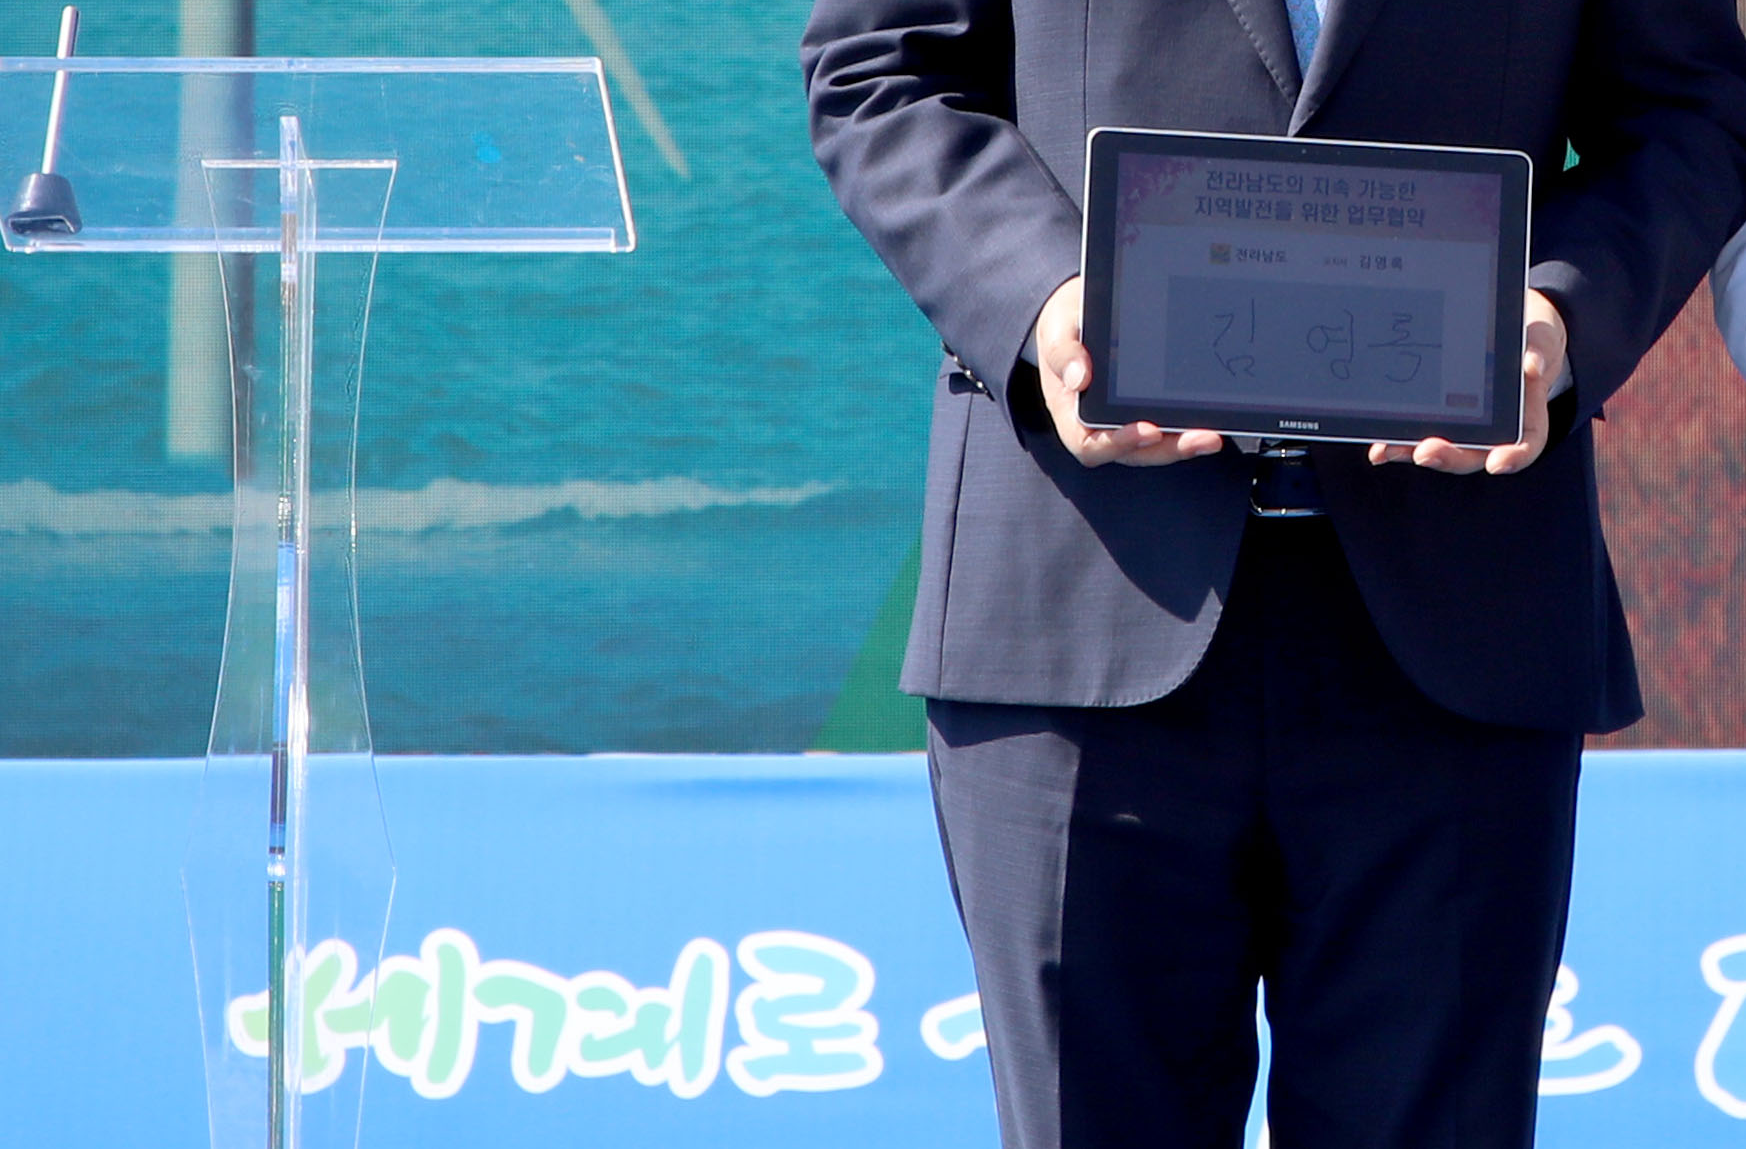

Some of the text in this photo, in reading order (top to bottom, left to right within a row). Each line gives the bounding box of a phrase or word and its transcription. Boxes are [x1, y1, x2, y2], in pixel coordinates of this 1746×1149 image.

[1205, 169, 1417, 202] 전라남도의 지속 가능한
[1194, 195, 1427, 228] 지역발전을 위한 업무협약
[1235, 247, 1288, 264] 전라남도
[1278, 419, 1320, 431] SAMSUNG
[226, 928, 884, 1099] 세계로
